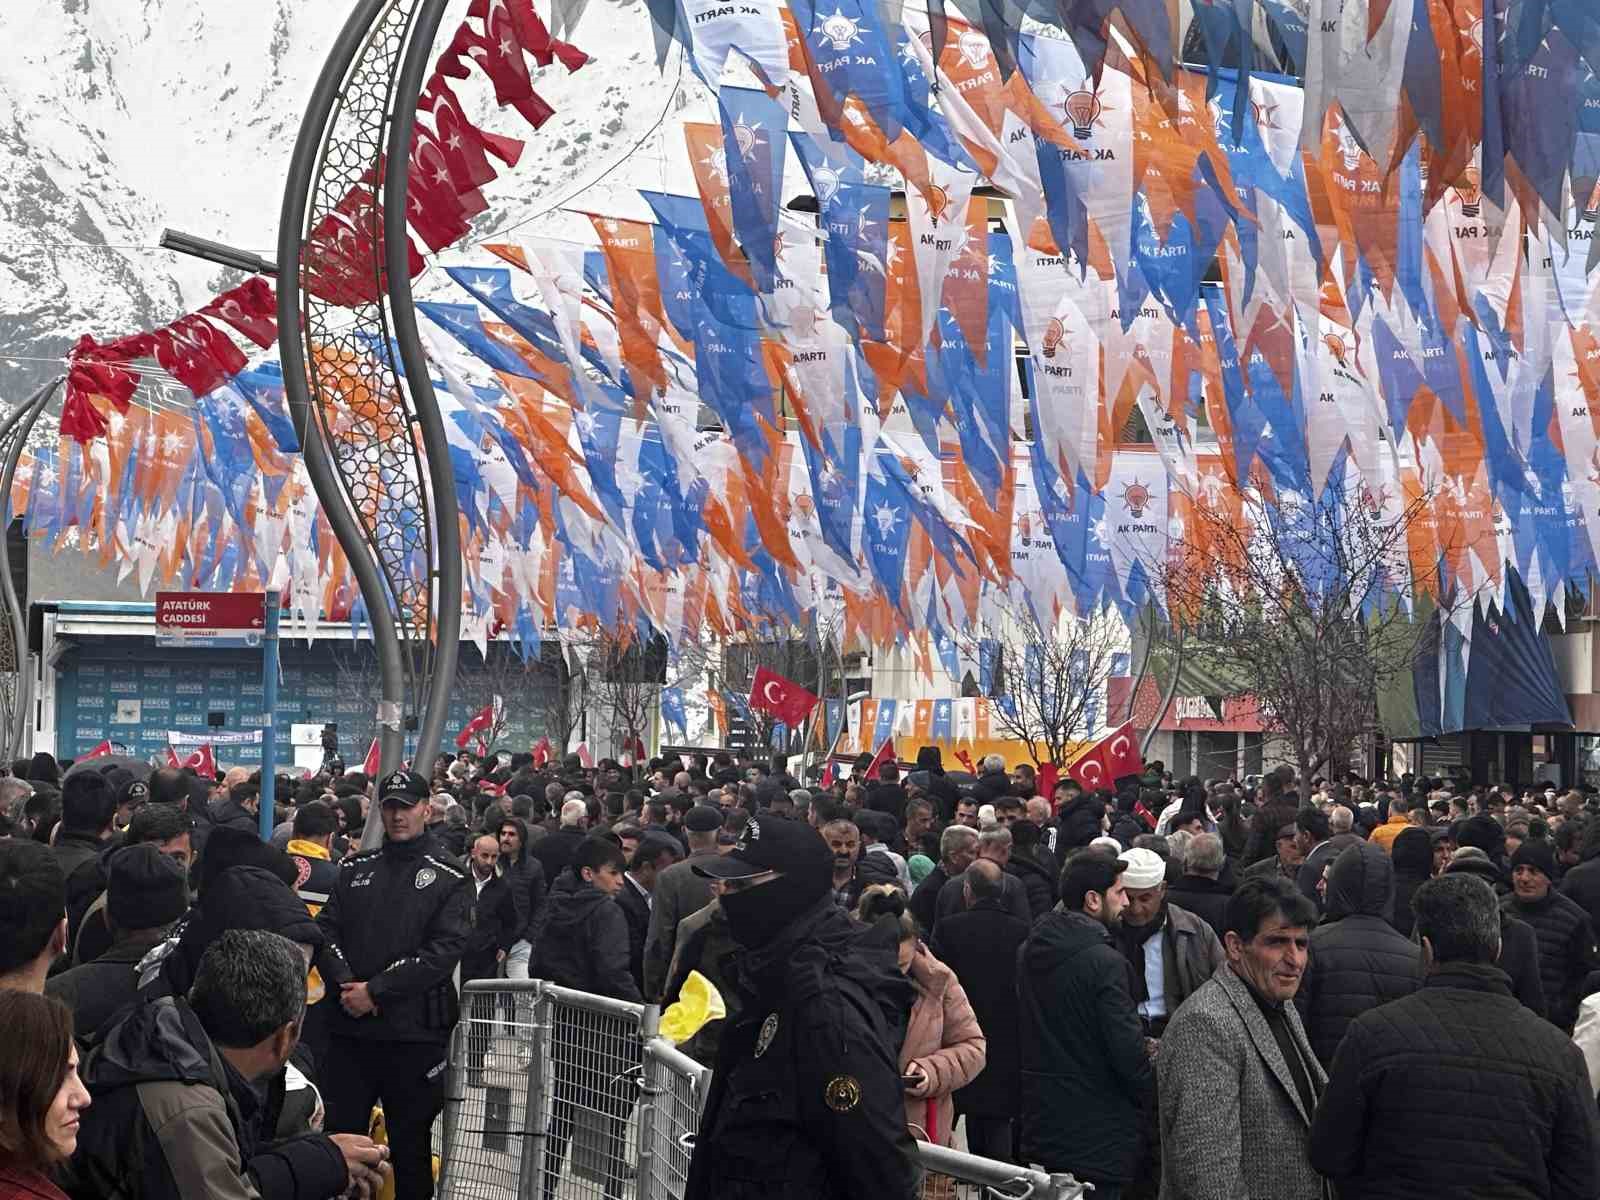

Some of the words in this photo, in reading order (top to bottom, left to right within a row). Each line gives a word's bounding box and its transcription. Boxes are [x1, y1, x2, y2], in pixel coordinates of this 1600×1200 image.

[1321, 20, 1336, 33] AK
[1010, 128, 1028, 143] AK
[921, 233, 935, 245] AK
[1320, 393, 1335, 402] AK
[1572, 407, 1586, 417] AK
[1118, 525, 1130, 533] AK
[162, 599, 211, 611] ATATÜRK
